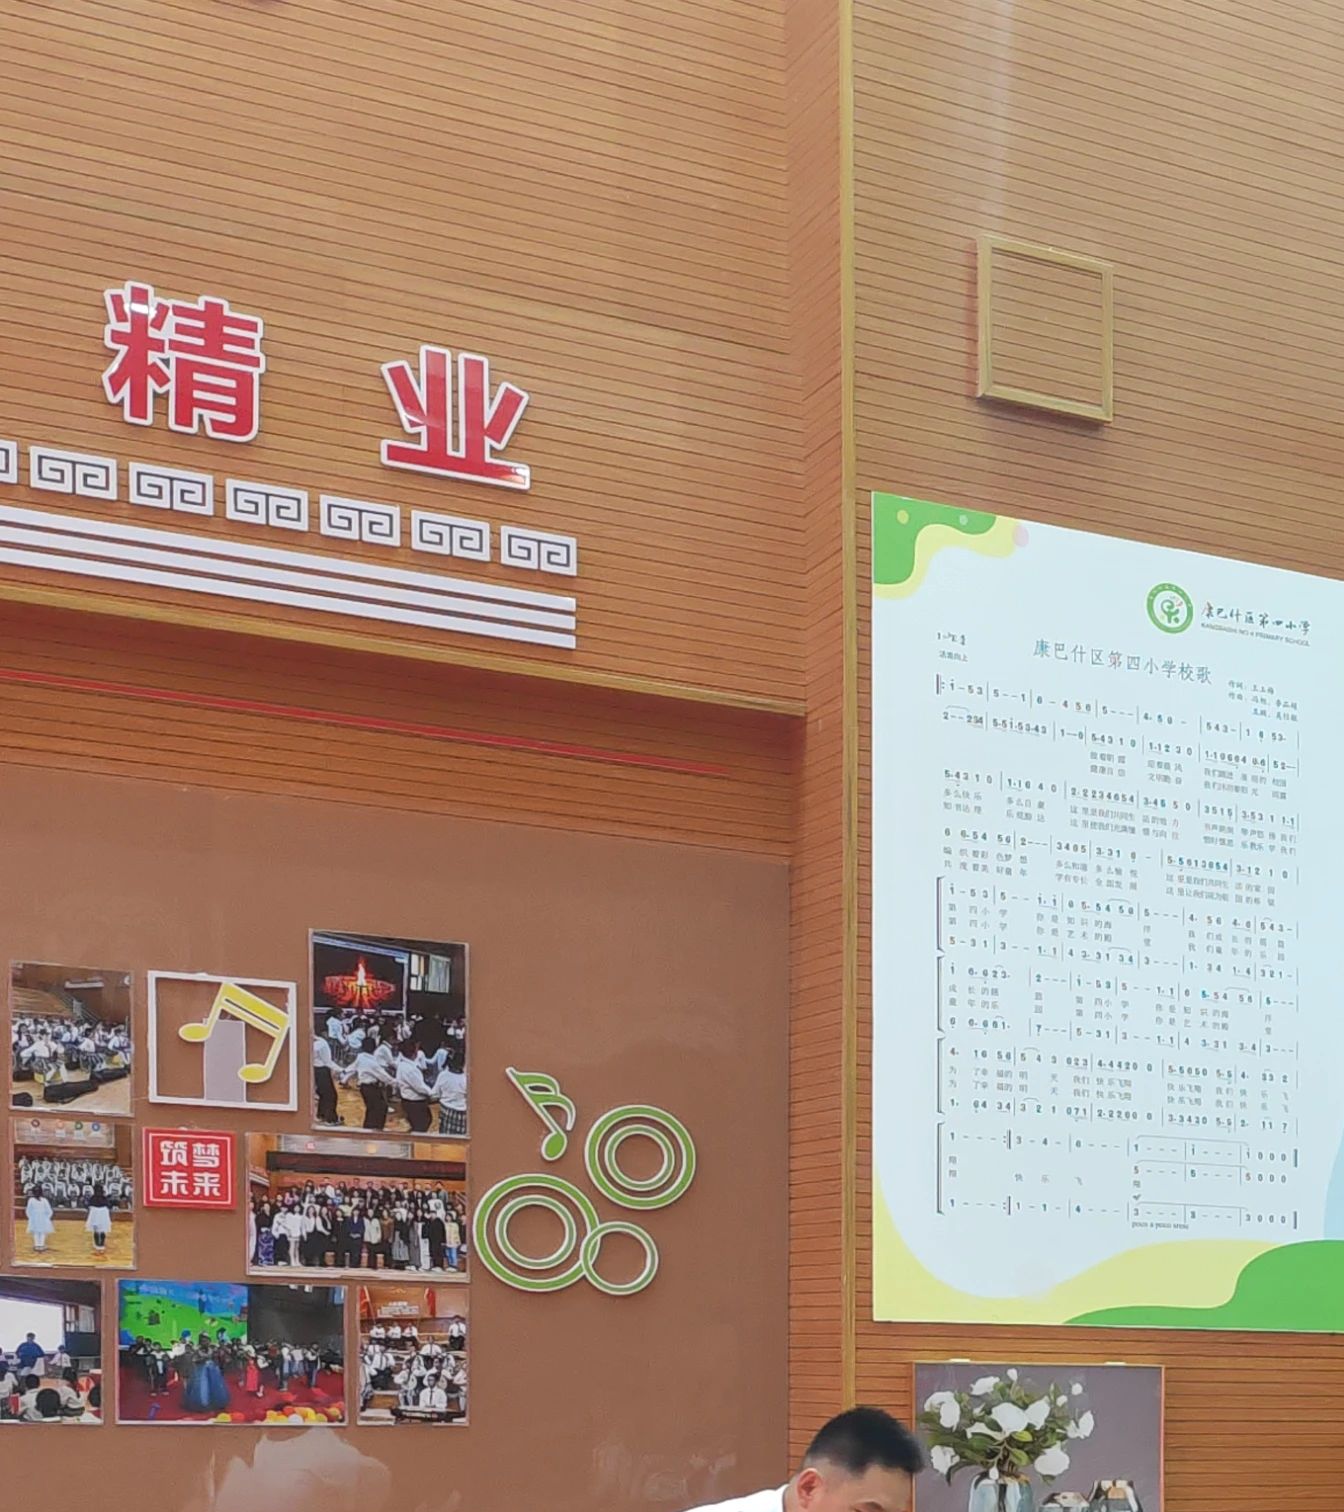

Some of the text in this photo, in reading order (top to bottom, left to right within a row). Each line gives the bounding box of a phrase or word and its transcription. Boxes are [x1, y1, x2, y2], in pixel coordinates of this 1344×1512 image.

[1201, 601, 1311, 636] 康巴什区第四小学
[1033, 638, 1213, 685] 康巴什区第四小学校歌
[160, 1140, 220, 1168] 筑梦
[160, 1170, 221, 1197] 未来
